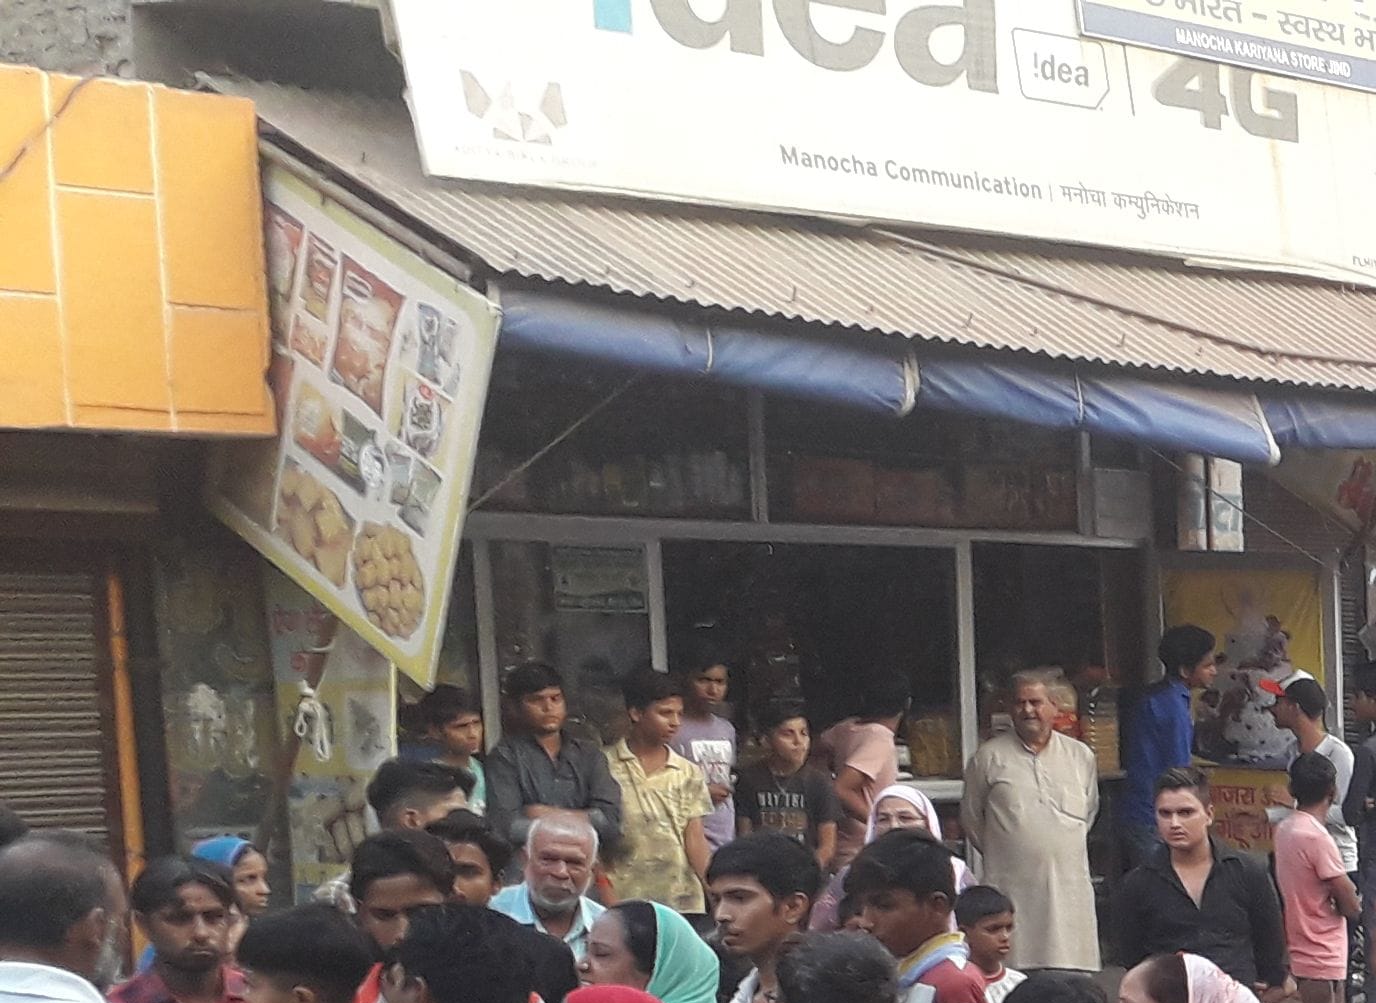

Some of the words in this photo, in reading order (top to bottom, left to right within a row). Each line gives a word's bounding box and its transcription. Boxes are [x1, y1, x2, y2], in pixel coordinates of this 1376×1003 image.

[1175, 27, 1234, 54] MANOCHA
[1233, 39, 1290, 65] KARIYANA
[1289, 51, 1327, 73] STORE
[1276, 10, 1346, 46] स्वस्थ
[1150, 55, 1299, 143] 4G
[779, 144, 878, 177] Manocha
[885, 159, 1042, 200] Communication
[1059, 180, 1106, 208] मनोचा
[1110, 190, 1200, 220] कम्युनिकेशन
